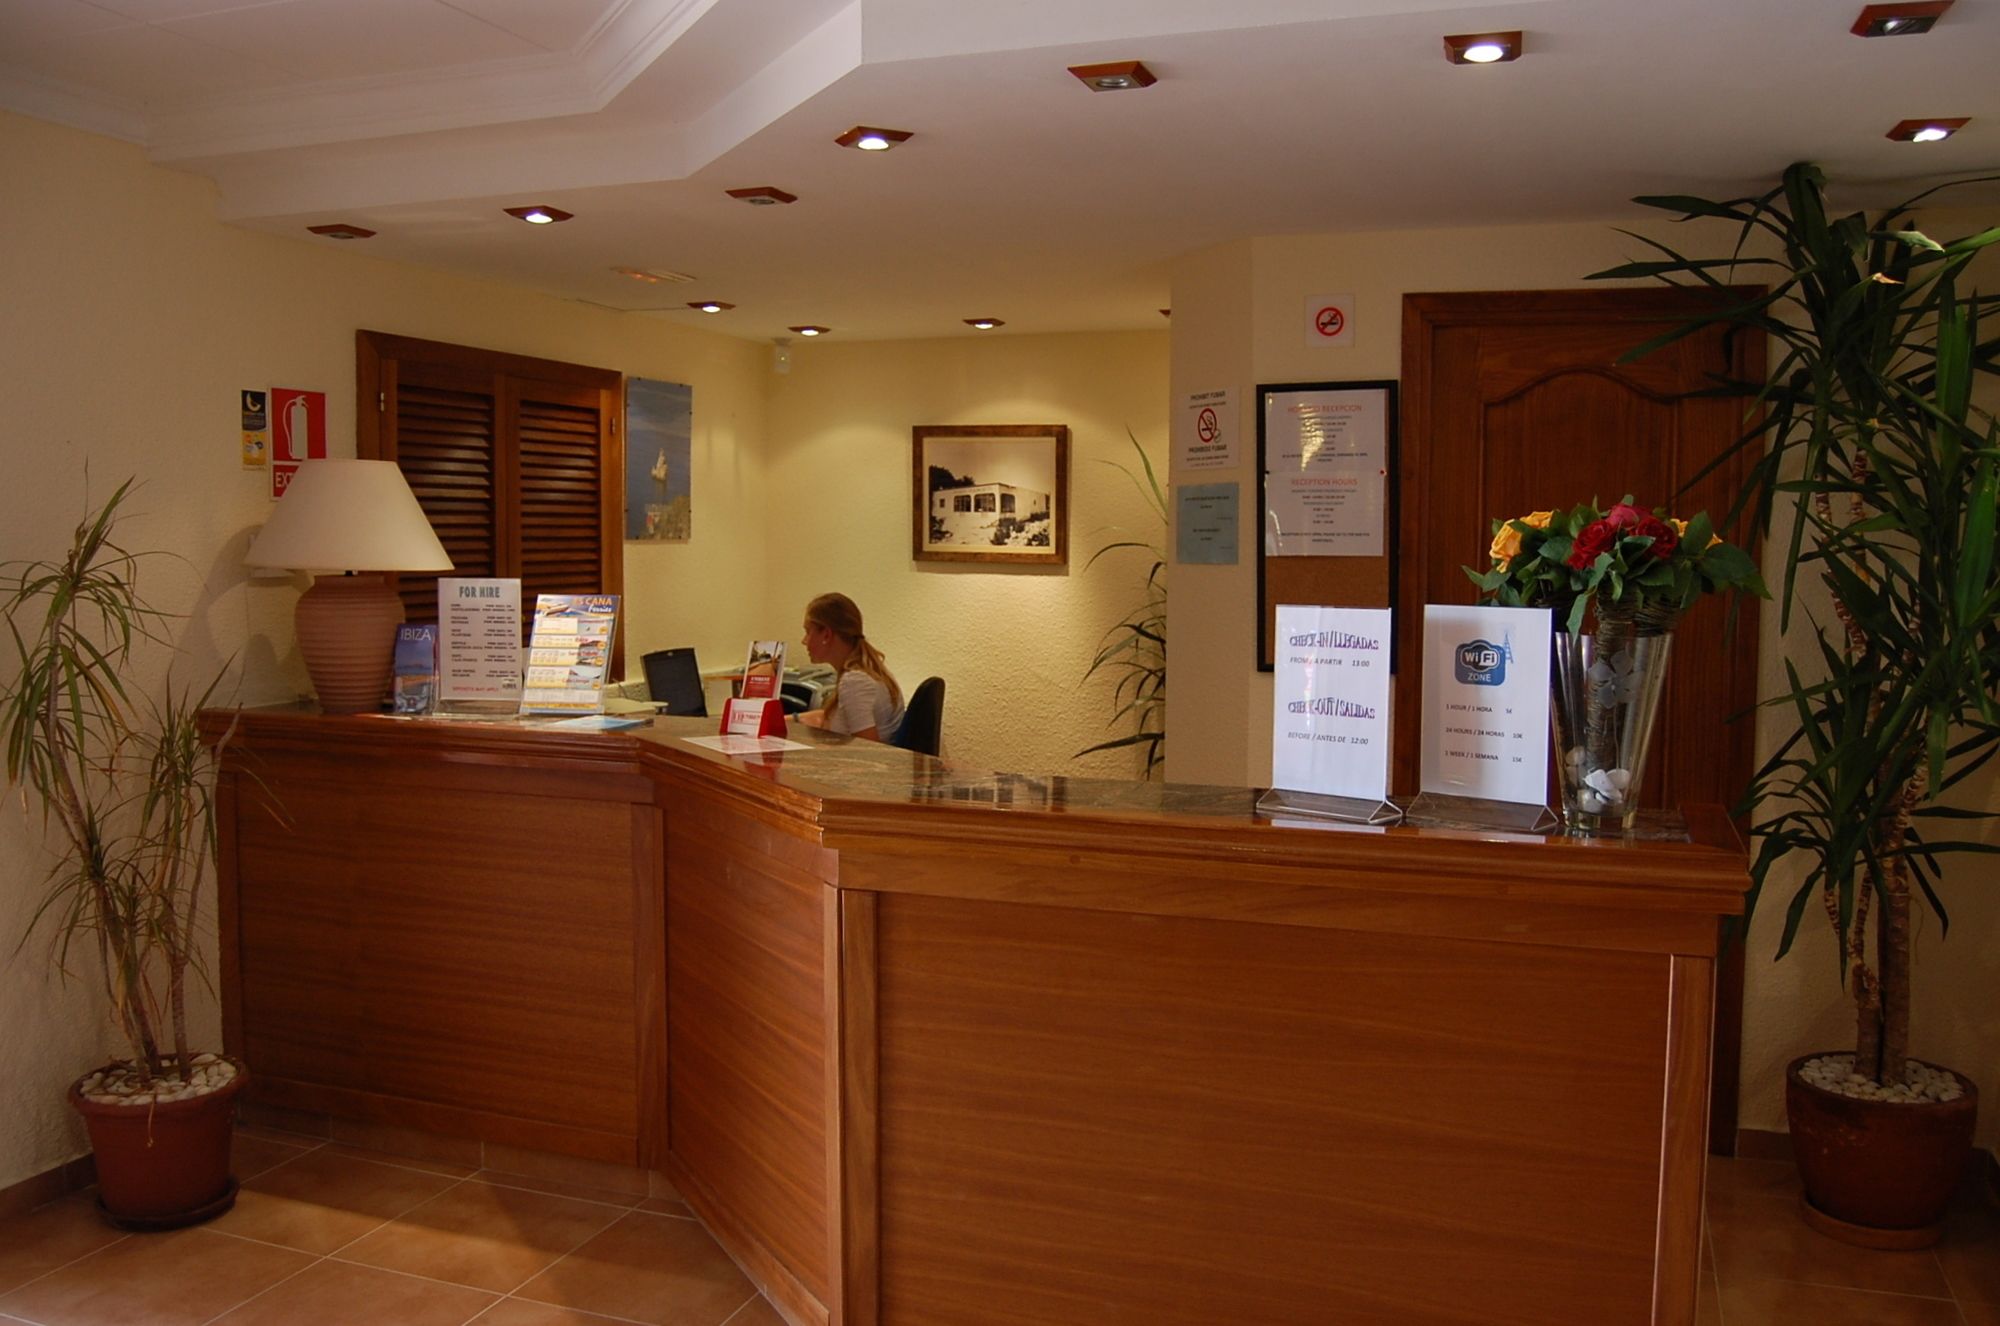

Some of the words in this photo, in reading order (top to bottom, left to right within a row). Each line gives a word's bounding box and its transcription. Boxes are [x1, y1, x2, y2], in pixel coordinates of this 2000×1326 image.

[1291, 478, 1330, 486] RECEPTION
[1332, 478, 1358, 486] HOURS
[459, 586, 477, 598] FOR
[479, 586, 501, 598] HIRE
[585, 597, 613, 605] CANA
[400, 627, 432, 641] IBIZA
[1289, 656, 1308, 664] FROM
[1467, 672, 1492, 682] ZONE
[1288, 731, 1311, 739] BEFORE
[1317, 734, 1336, 742] ANTES
[1337, 735, 1346, 743] DE
[1475, 753, 1499, 761] SEMANA
